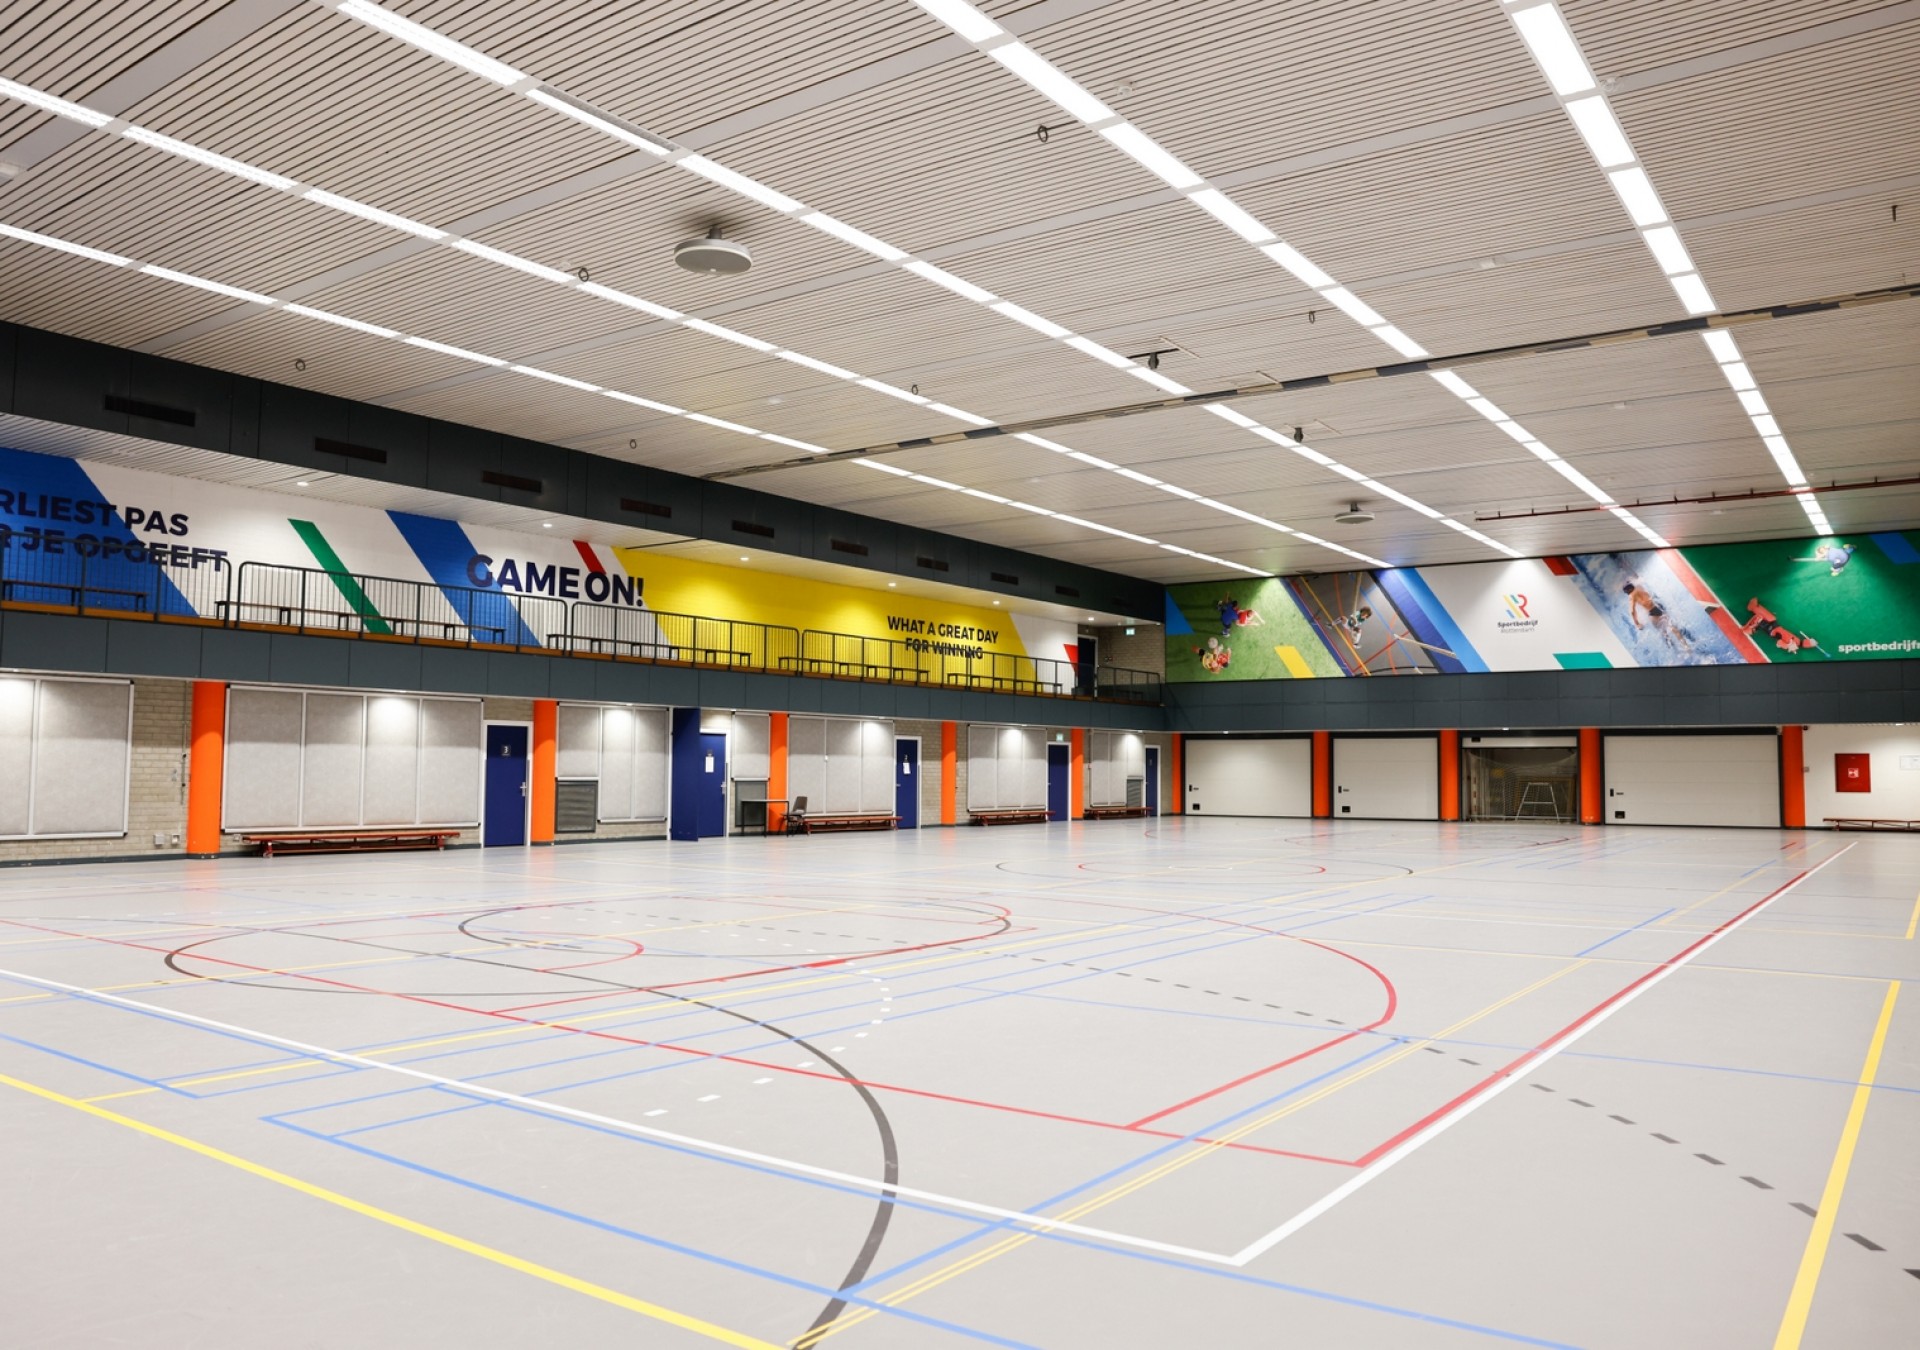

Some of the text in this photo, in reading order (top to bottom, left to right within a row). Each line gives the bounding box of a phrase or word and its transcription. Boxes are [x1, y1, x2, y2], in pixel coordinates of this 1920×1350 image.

[125, 507, 189, 536] PAS
[22, 526, 64, 554] JE
[74, 533, 228, 572] OPGEEFT
[467, 554, 644, 607] GAME ON!
[887, 615, 999, 644] WHAT A GREAT DAY
[1497, 620, 1538, 628] Sportbedrijf
[905, 637, 984, 660] FOR WINNING
